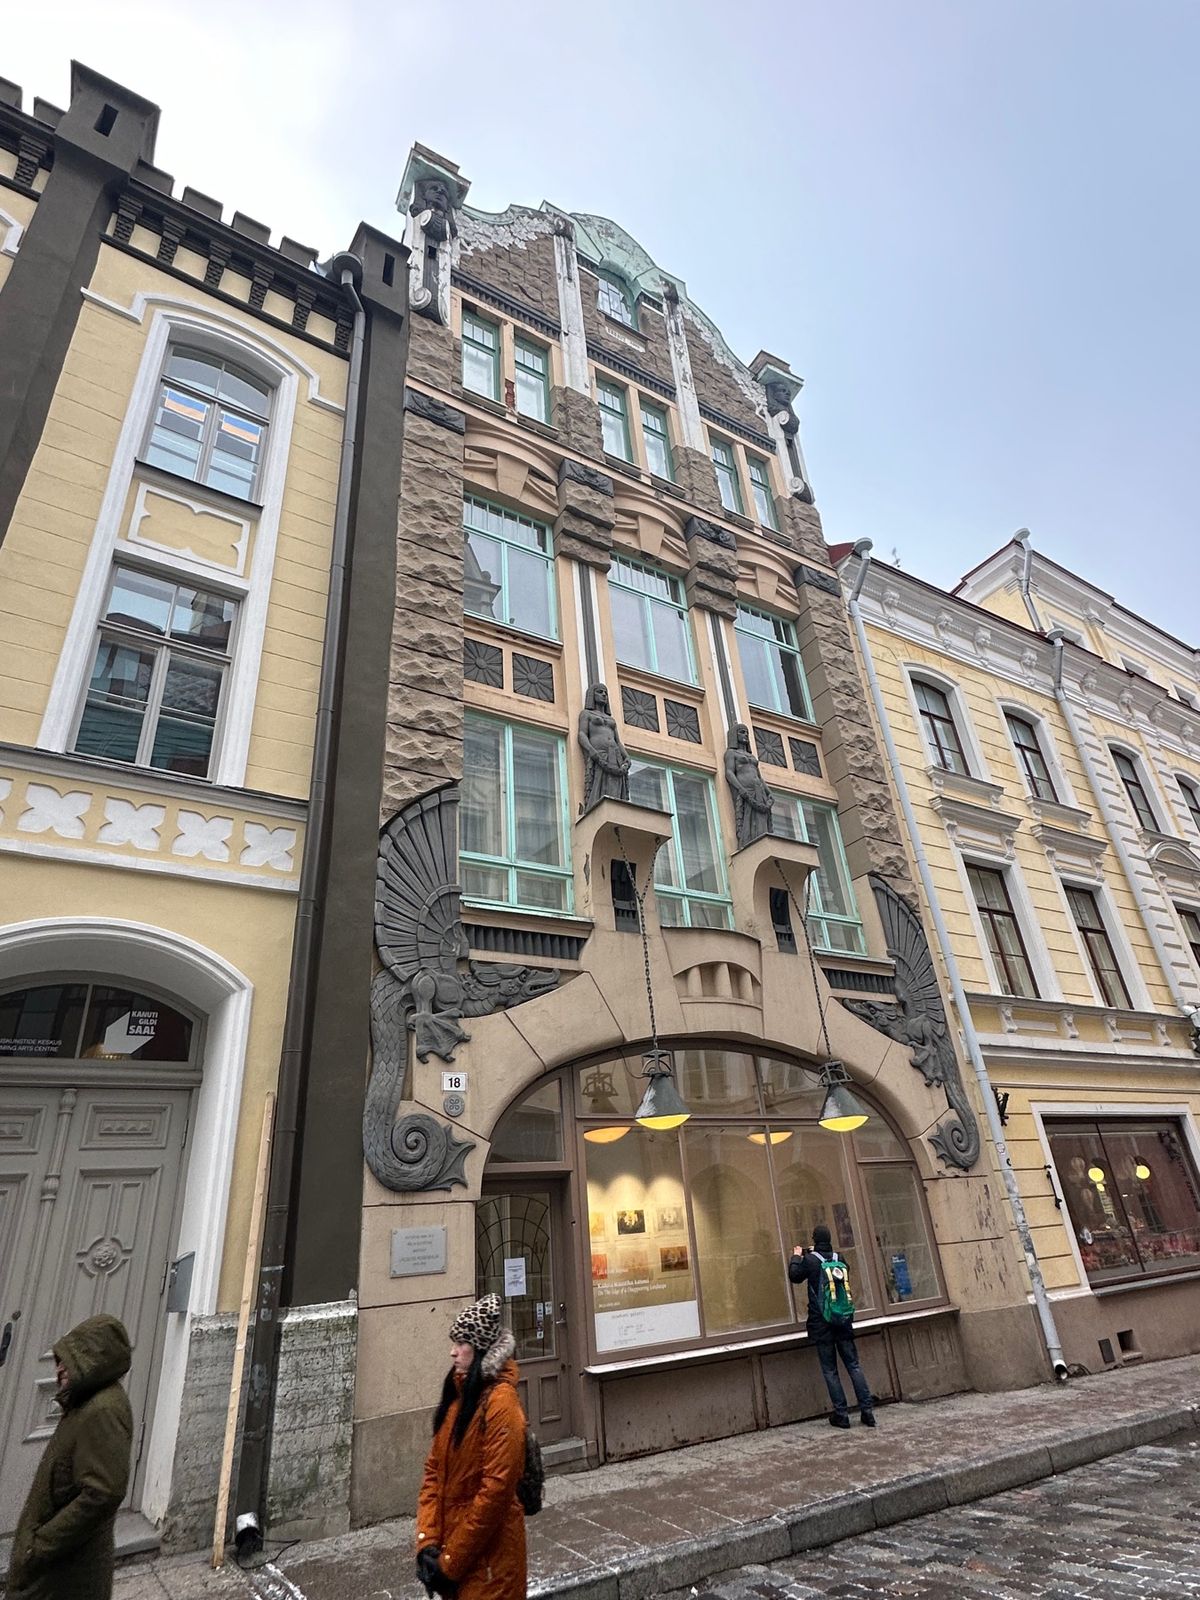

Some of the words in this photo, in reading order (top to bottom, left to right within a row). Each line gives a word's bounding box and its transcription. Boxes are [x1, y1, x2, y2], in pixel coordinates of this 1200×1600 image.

[131, 1010, 159, 1018] KANUTI
[138, 1018, 158, 1026] GILDI
[128, 1025, 156, 1035] SAAL
[448, 1077, 461, 1088] 18
